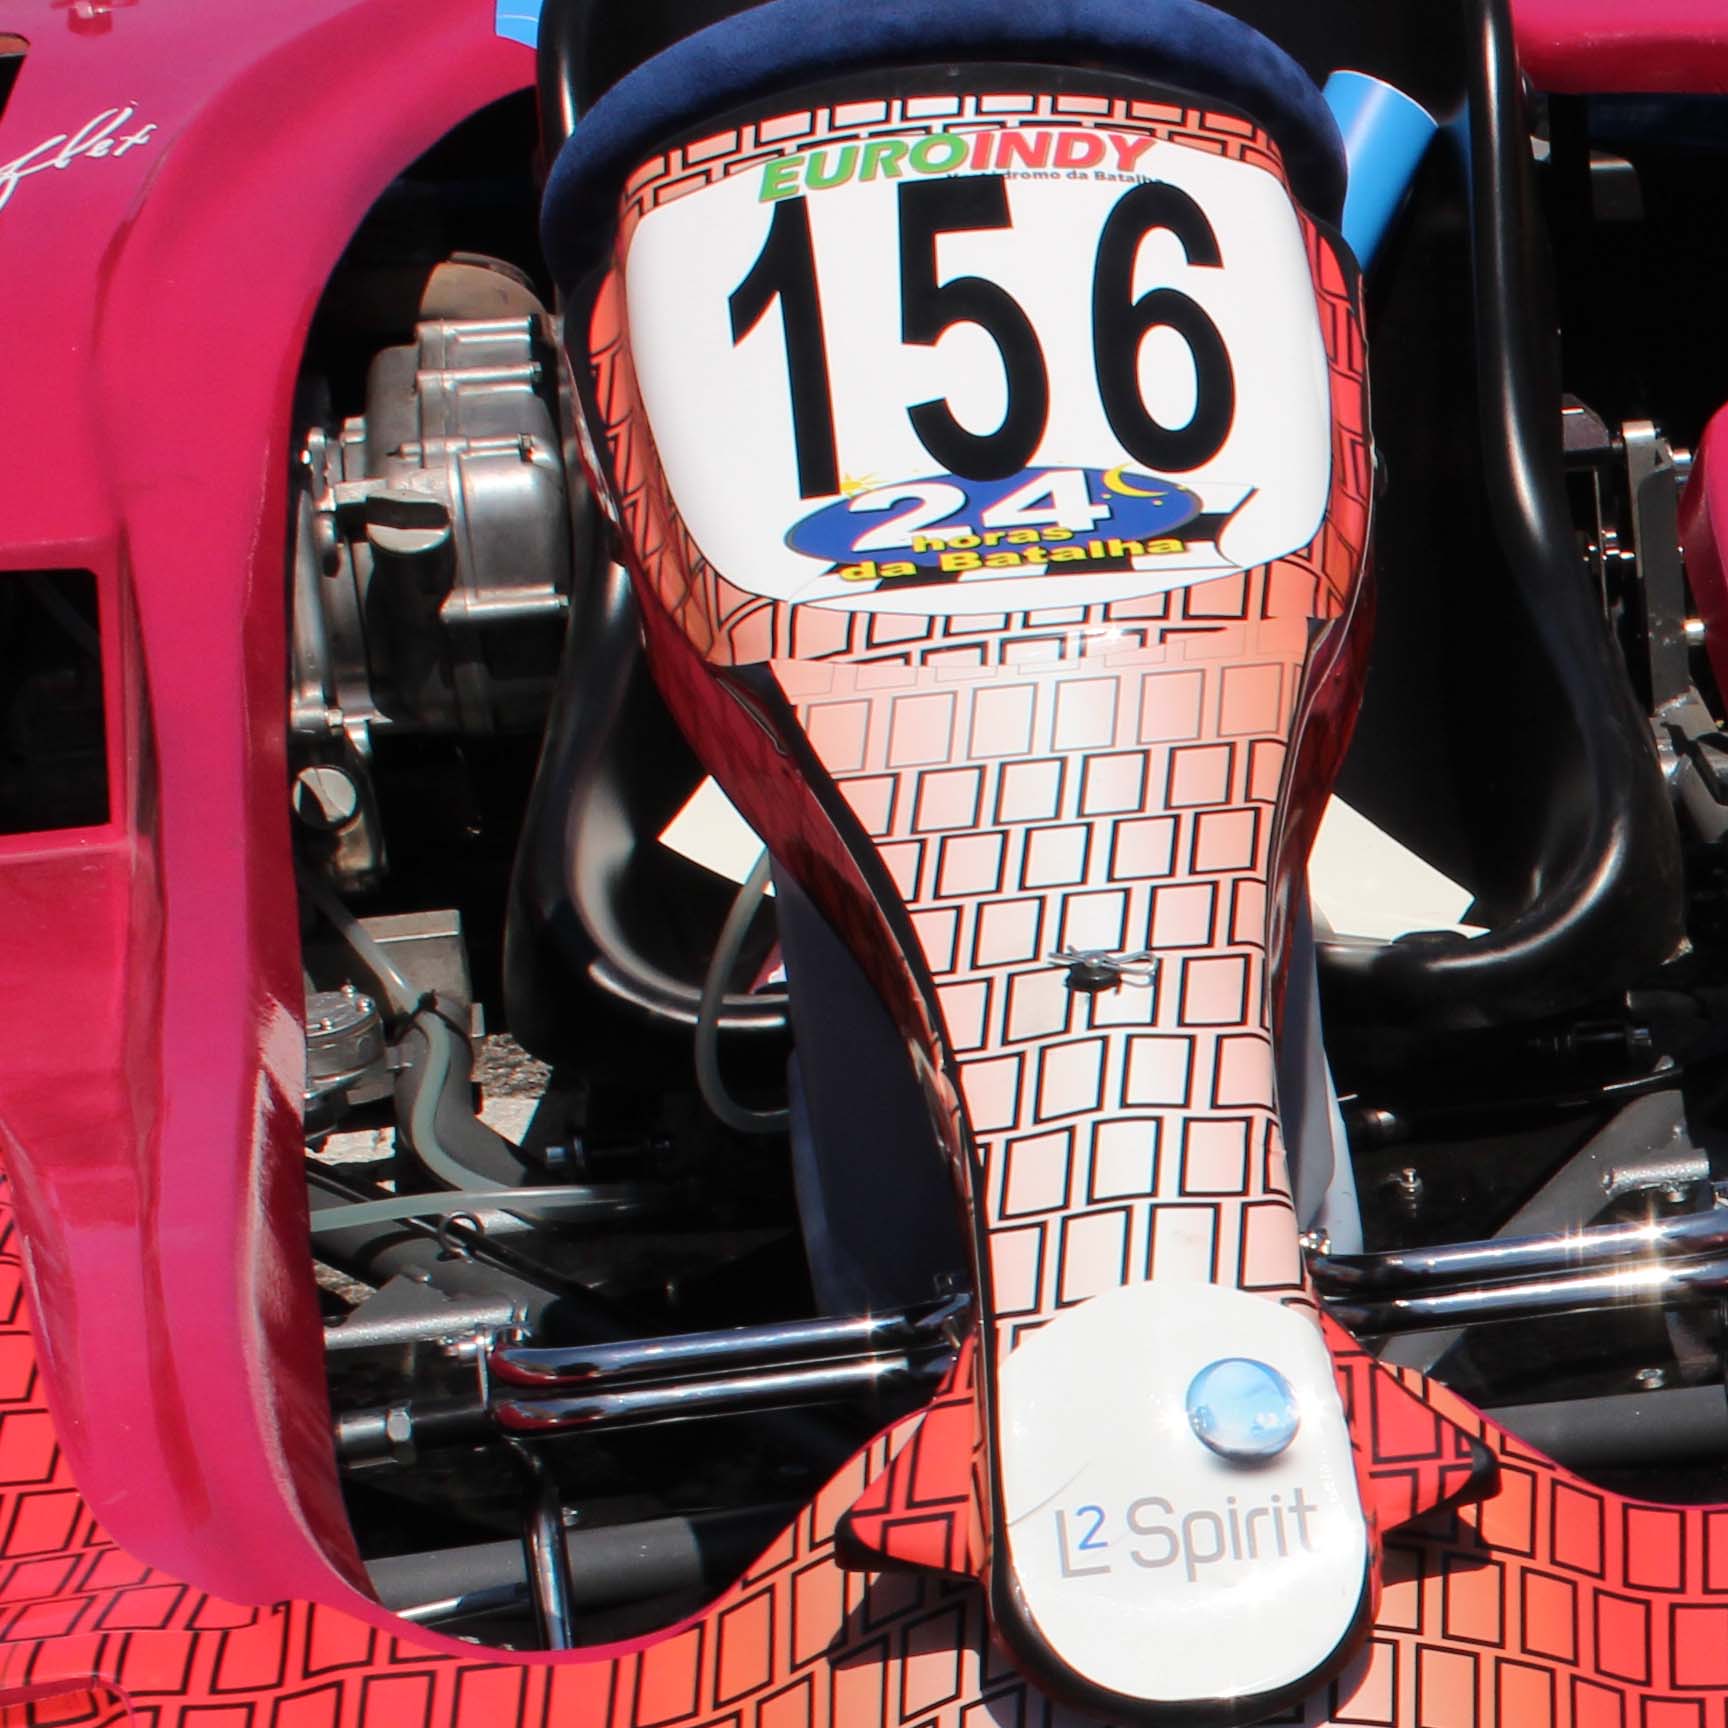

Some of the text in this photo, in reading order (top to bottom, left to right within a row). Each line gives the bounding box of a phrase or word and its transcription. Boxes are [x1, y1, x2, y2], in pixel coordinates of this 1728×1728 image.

[757, 130, 1158, 203] EUROINDY
[1065, 169, 1089, 181] da
[727, 172, 1236, 501] 156
[848, 469, 1113, 553] 24
[910, 525, 1075, 554] horas
[838, 537, 1186, 582] da Batalha
[1126, 1487, 1318, 1583] Spirit
